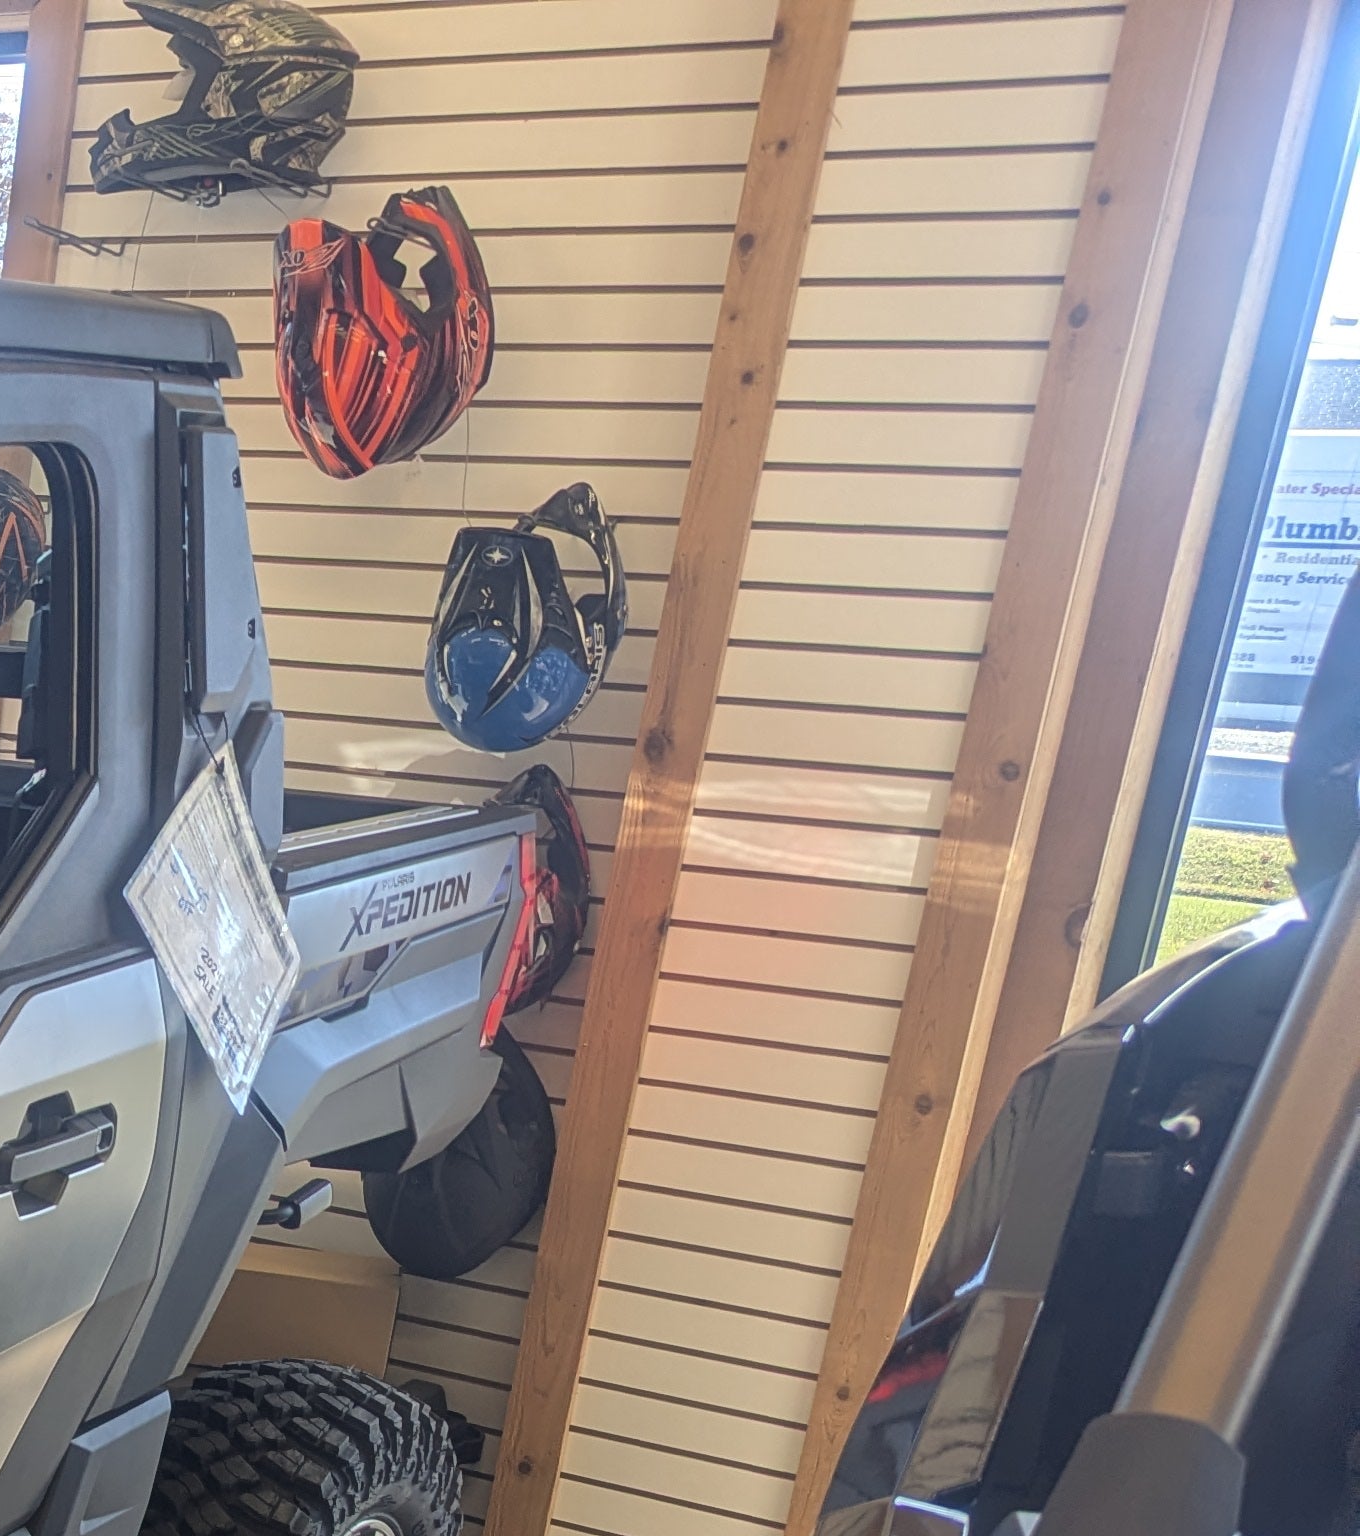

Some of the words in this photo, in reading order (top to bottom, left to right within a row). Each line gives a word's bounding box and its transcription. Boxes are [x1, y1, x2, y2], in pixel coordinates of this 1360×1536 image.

[1276, 483, 1307, 495] ater
[1266, 515, 1360, 540] lumb
[1255, 573, 1293, 586] ency
[1296, 572, 1348, 586] Servic
[338, 871, 471, 952] XPEDITION
[193, 963, 217, 1000] SALE
